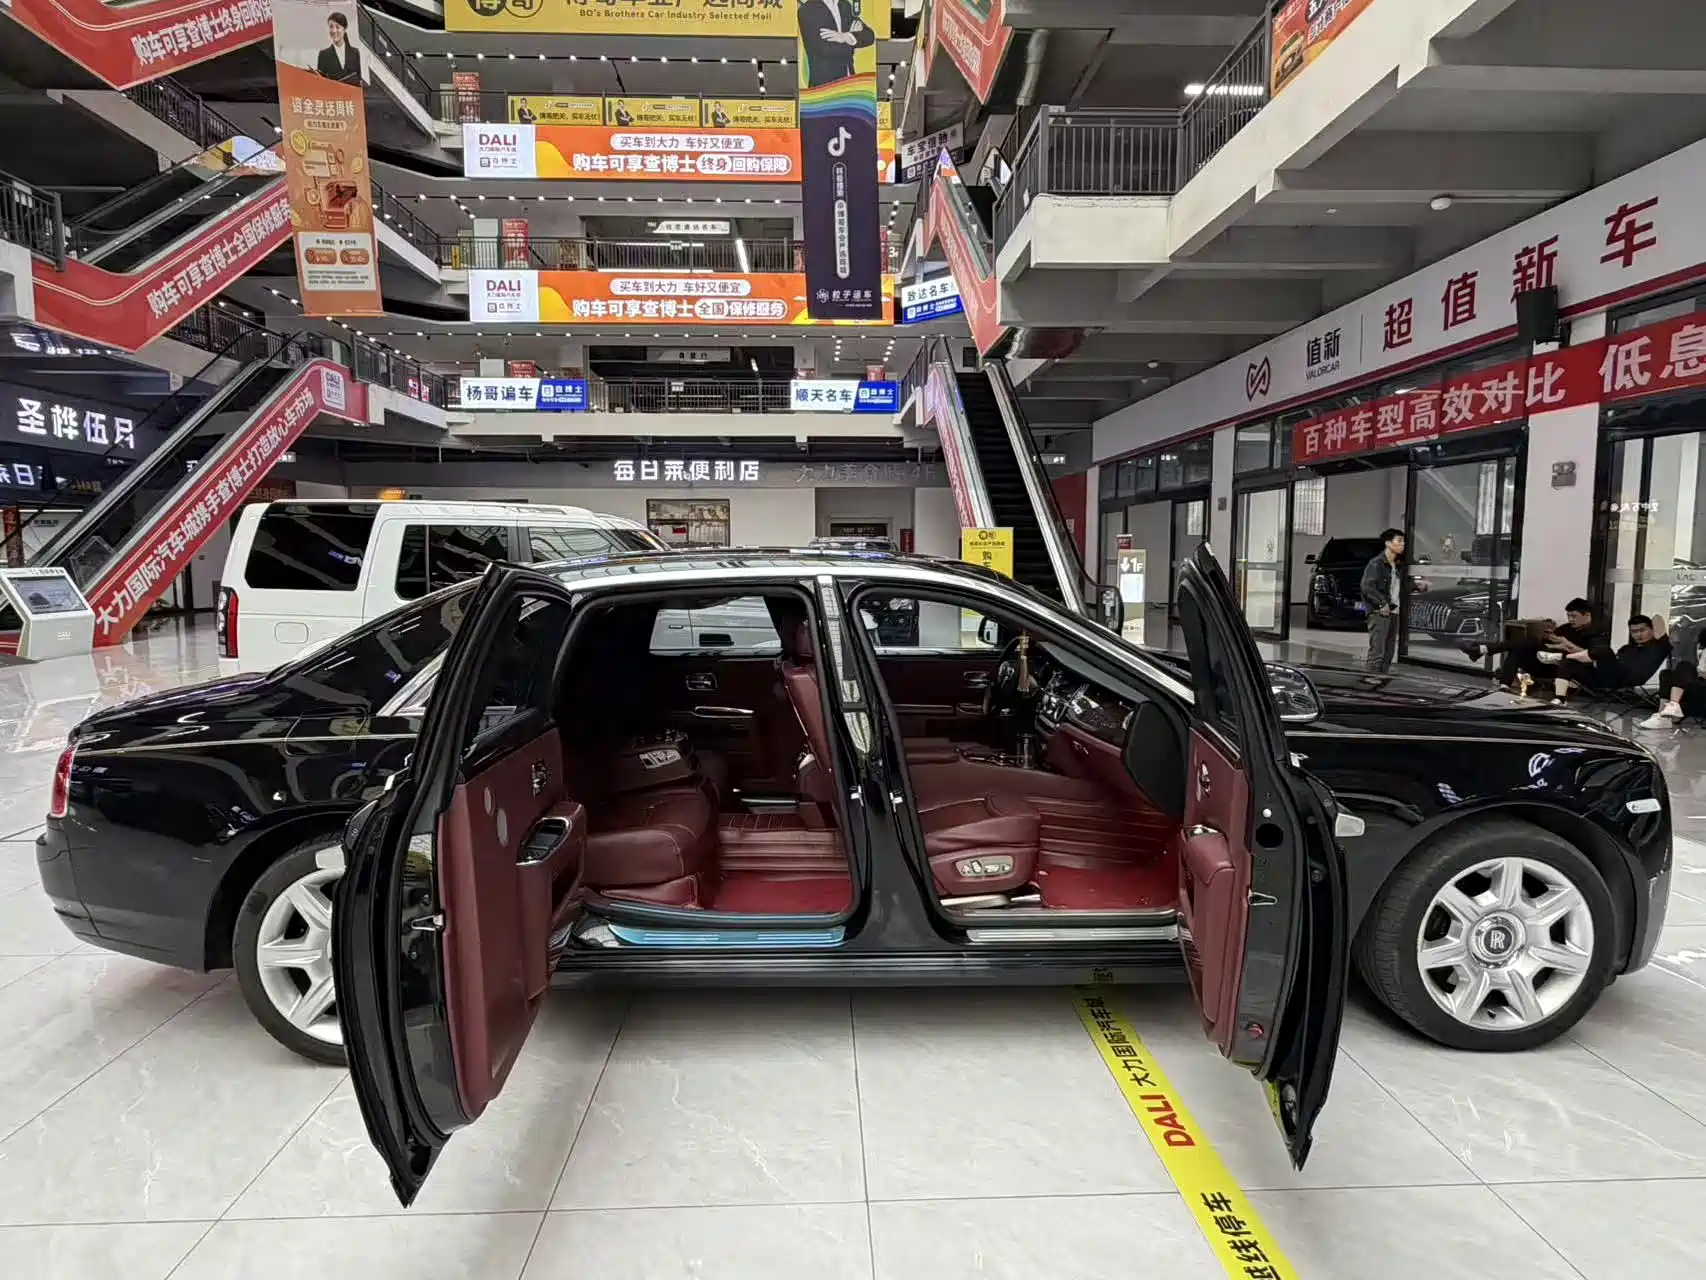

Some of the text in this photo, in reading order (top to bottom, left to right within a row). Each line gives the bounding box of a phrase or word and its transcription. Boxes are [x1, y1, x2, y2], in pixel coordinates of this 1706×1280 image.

[604, 9, 645, 19] Brothers
[648, 10, 664, 19] Car
[667, 10, 706, 21] Industry
[709, 11, 749, 21] Selected
[478, 133, 517, 146] DALI
[620, 136, 745, 150] 买车到大力 车好又便宜
[1382, 197, 1659, 352] 超值新车
[486, 279, 521, 291] DALI
[619, 280, 741, 294] 买车到大力 车好又便宜
[1307, 327, 1341, 368] 值新
[1303, 324, 1706, 456] 百种车型高效对比 低息
[1130, 557, 1143, 573] 1F
[1139, 1094, 1196, 1147] DALI
